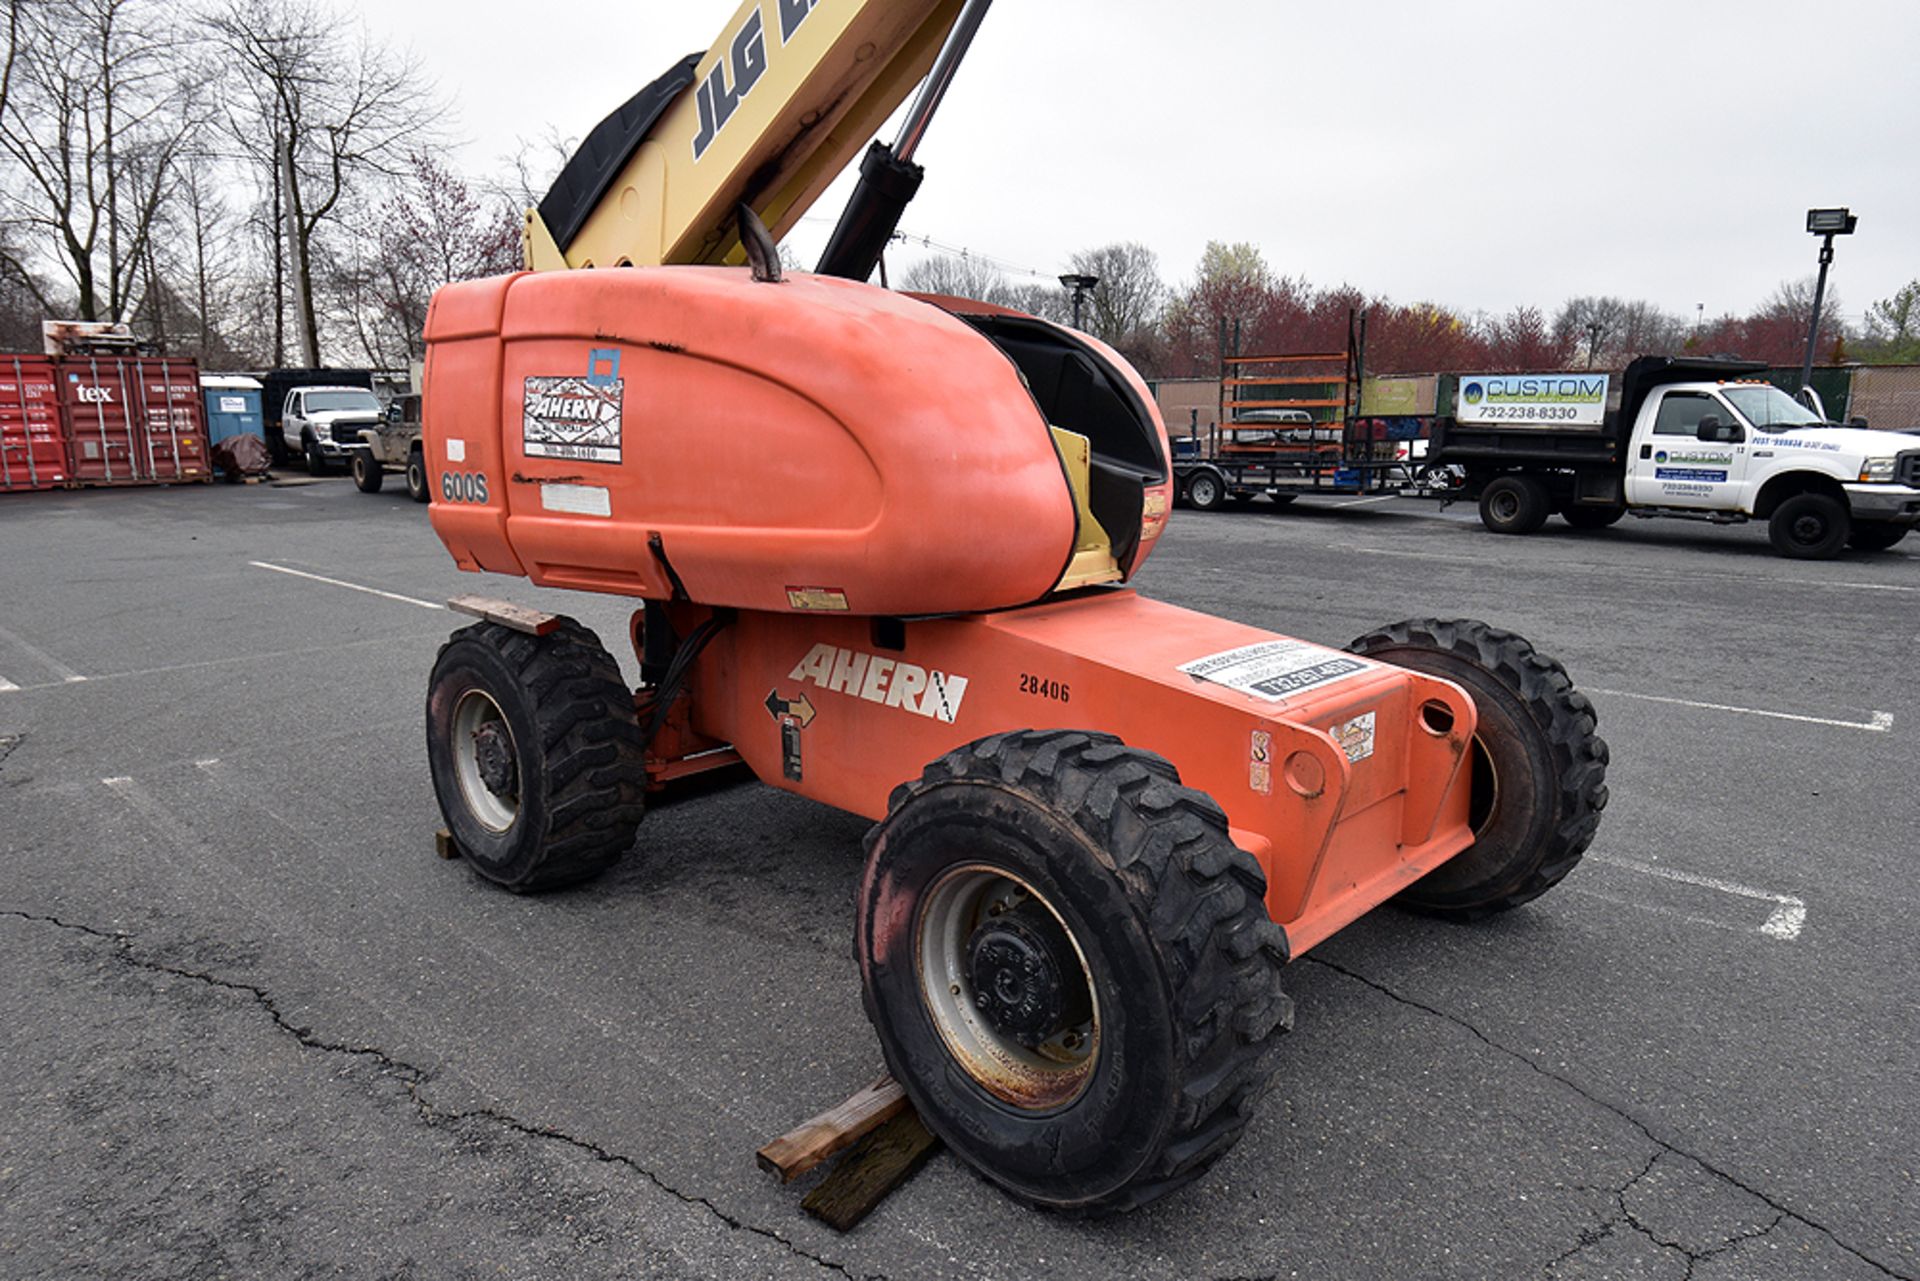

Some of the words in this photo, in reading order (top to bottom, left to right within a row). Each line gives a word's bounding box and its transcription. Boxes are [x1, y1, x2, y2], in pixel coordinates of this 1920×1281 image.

[692, 5, 768, 163] JLG
[777, 0, 822, 47] L
[76, 384, 114, 402] tex
[1487, 380, 1604, 396] CUSTOM
[533, 397, 600, 419] AHERN
[1479, 407, 1577, 420] 732-238-8330
[441, 471, 489, 504] 600S
[788, 643, 968, 725] AHERN
[1019, 673, 1071, 702] 28406
